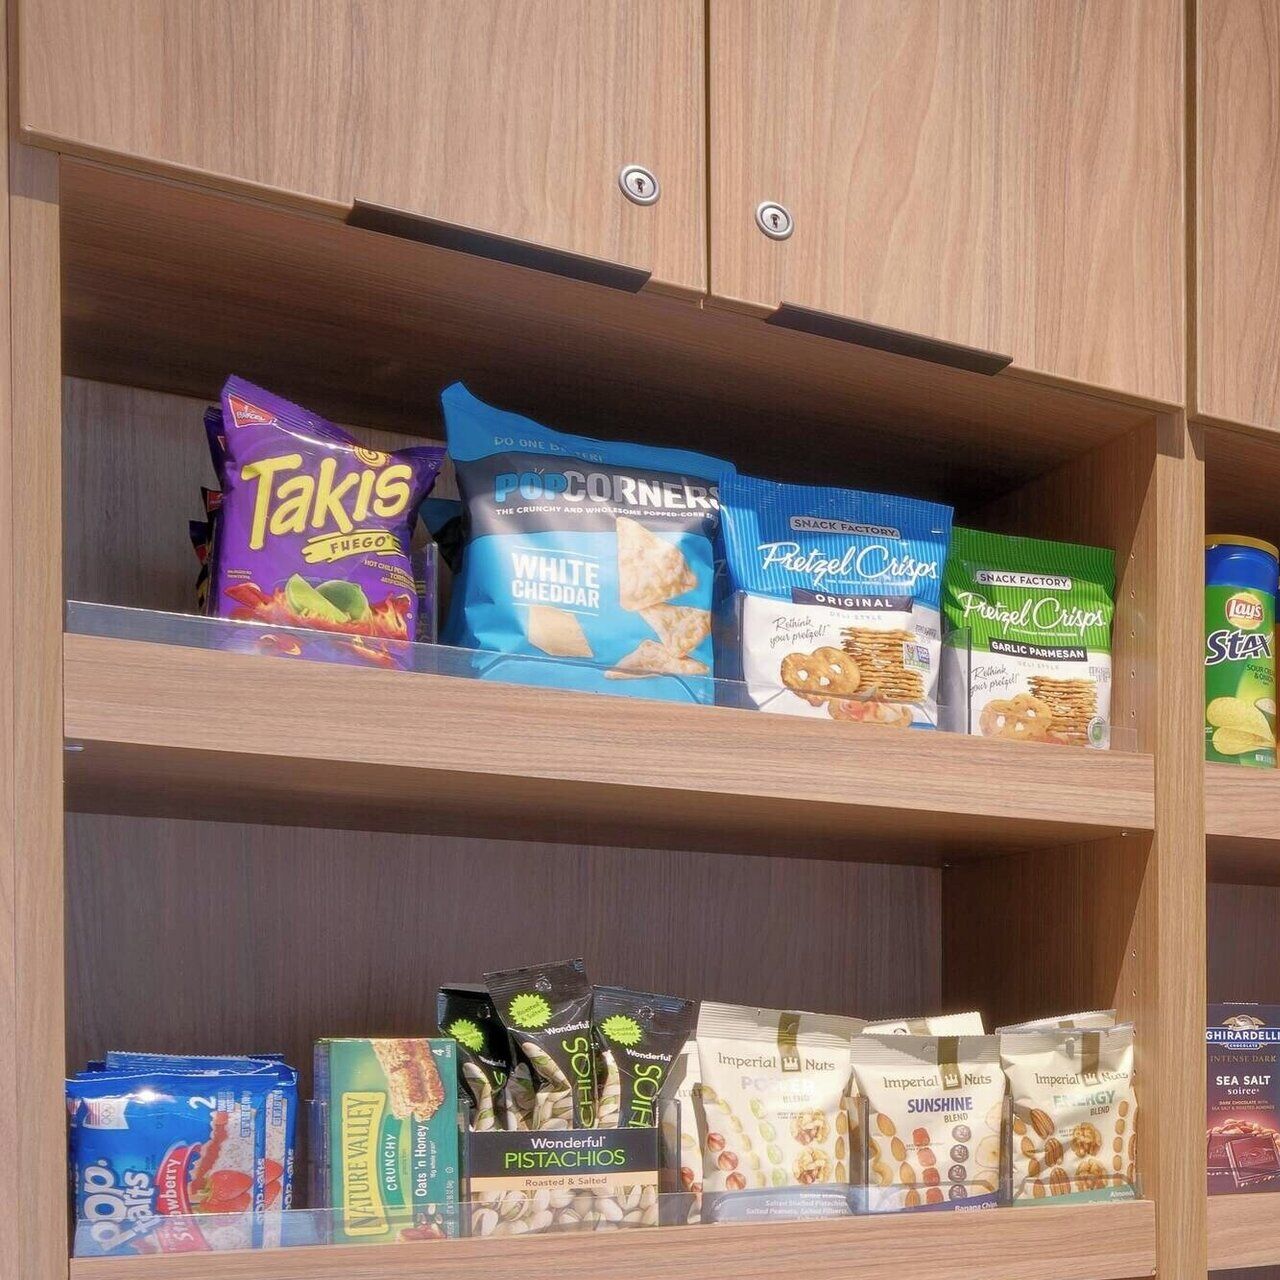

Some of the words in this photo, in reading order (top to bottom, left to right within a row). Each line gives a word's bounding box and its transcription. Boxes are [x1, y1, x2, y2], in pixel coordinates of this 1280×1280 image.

[189, 95, 216, 110] 2
[241, 453, 413, 550] Takis
[496, 508, 514, 516] THE
[517, 505, 562, 515] CRUNCHY
[564, 506, 583, 514] AND
[586, 506, 642, 516] WHOLESOME
[643, 510, 705, 518] POPPED-CORN
[794, 519, 837, 531] SNACK
[840, 523, 896, 537] FACTORY
[330, 535, 386, 554] FUEGO
[511, 552, 600, 589] WHITE
[757, 541, 856, 587] Pretzel
[856, 545, 938, 586] Crisps
[980, 573, 1017, 584] SNACK
[1020, 576, 1068, 587] FACTORY
[511, 579, 600, 609] CHEDDAR
[815, 594, 893, 608] ORIGINAL
[957, 592, 1033, 635] Pretzel
[1032, 597, 1104, 637] Crisps
[1229, 599, 1262, 619] Lay's
[772, 615, 814, 632] Rethink
[991, 641, 1028, 655] GARLIC
[1029, 646, 1085, 659] PARMESAN
[544, 1020, 590, 1036] Wonderful
[1206, 1030, 1280, 1041] GHIRARDELLI
[625, 1048, 673, 1062] Wonderful
[717, 1051, 777, 1069] Imperial
[805, 1057, 836, 1072] Nuts
[883, 1075, 940, 1090] Imperial
[964, 1074, 993, 1086] Nuts
[1216, 1075, 1241, 1086] SEA
[1243, 1075, 1271, 1086] SALT
[907, 1096, 973, 1114] SUNSHINE
[943, 1112, 969, 1123] BLEND
[347, 1096, 380, 1159] VALLEY
[414, 1124, 430, 1159] Honey
[531, 1136, 604, 1150] Wonderful
[385, 1133, 397, 1192] CRUNCHY
[504, 1149, 626, 1169] PISTACHIOS
[414, 1172, 428, 1198] Oats
[525, 1178, 565, 1187] Roasted
[578, 1177, 607, 1186] Salted
[347, 1158, 382, 1229] NATURE
